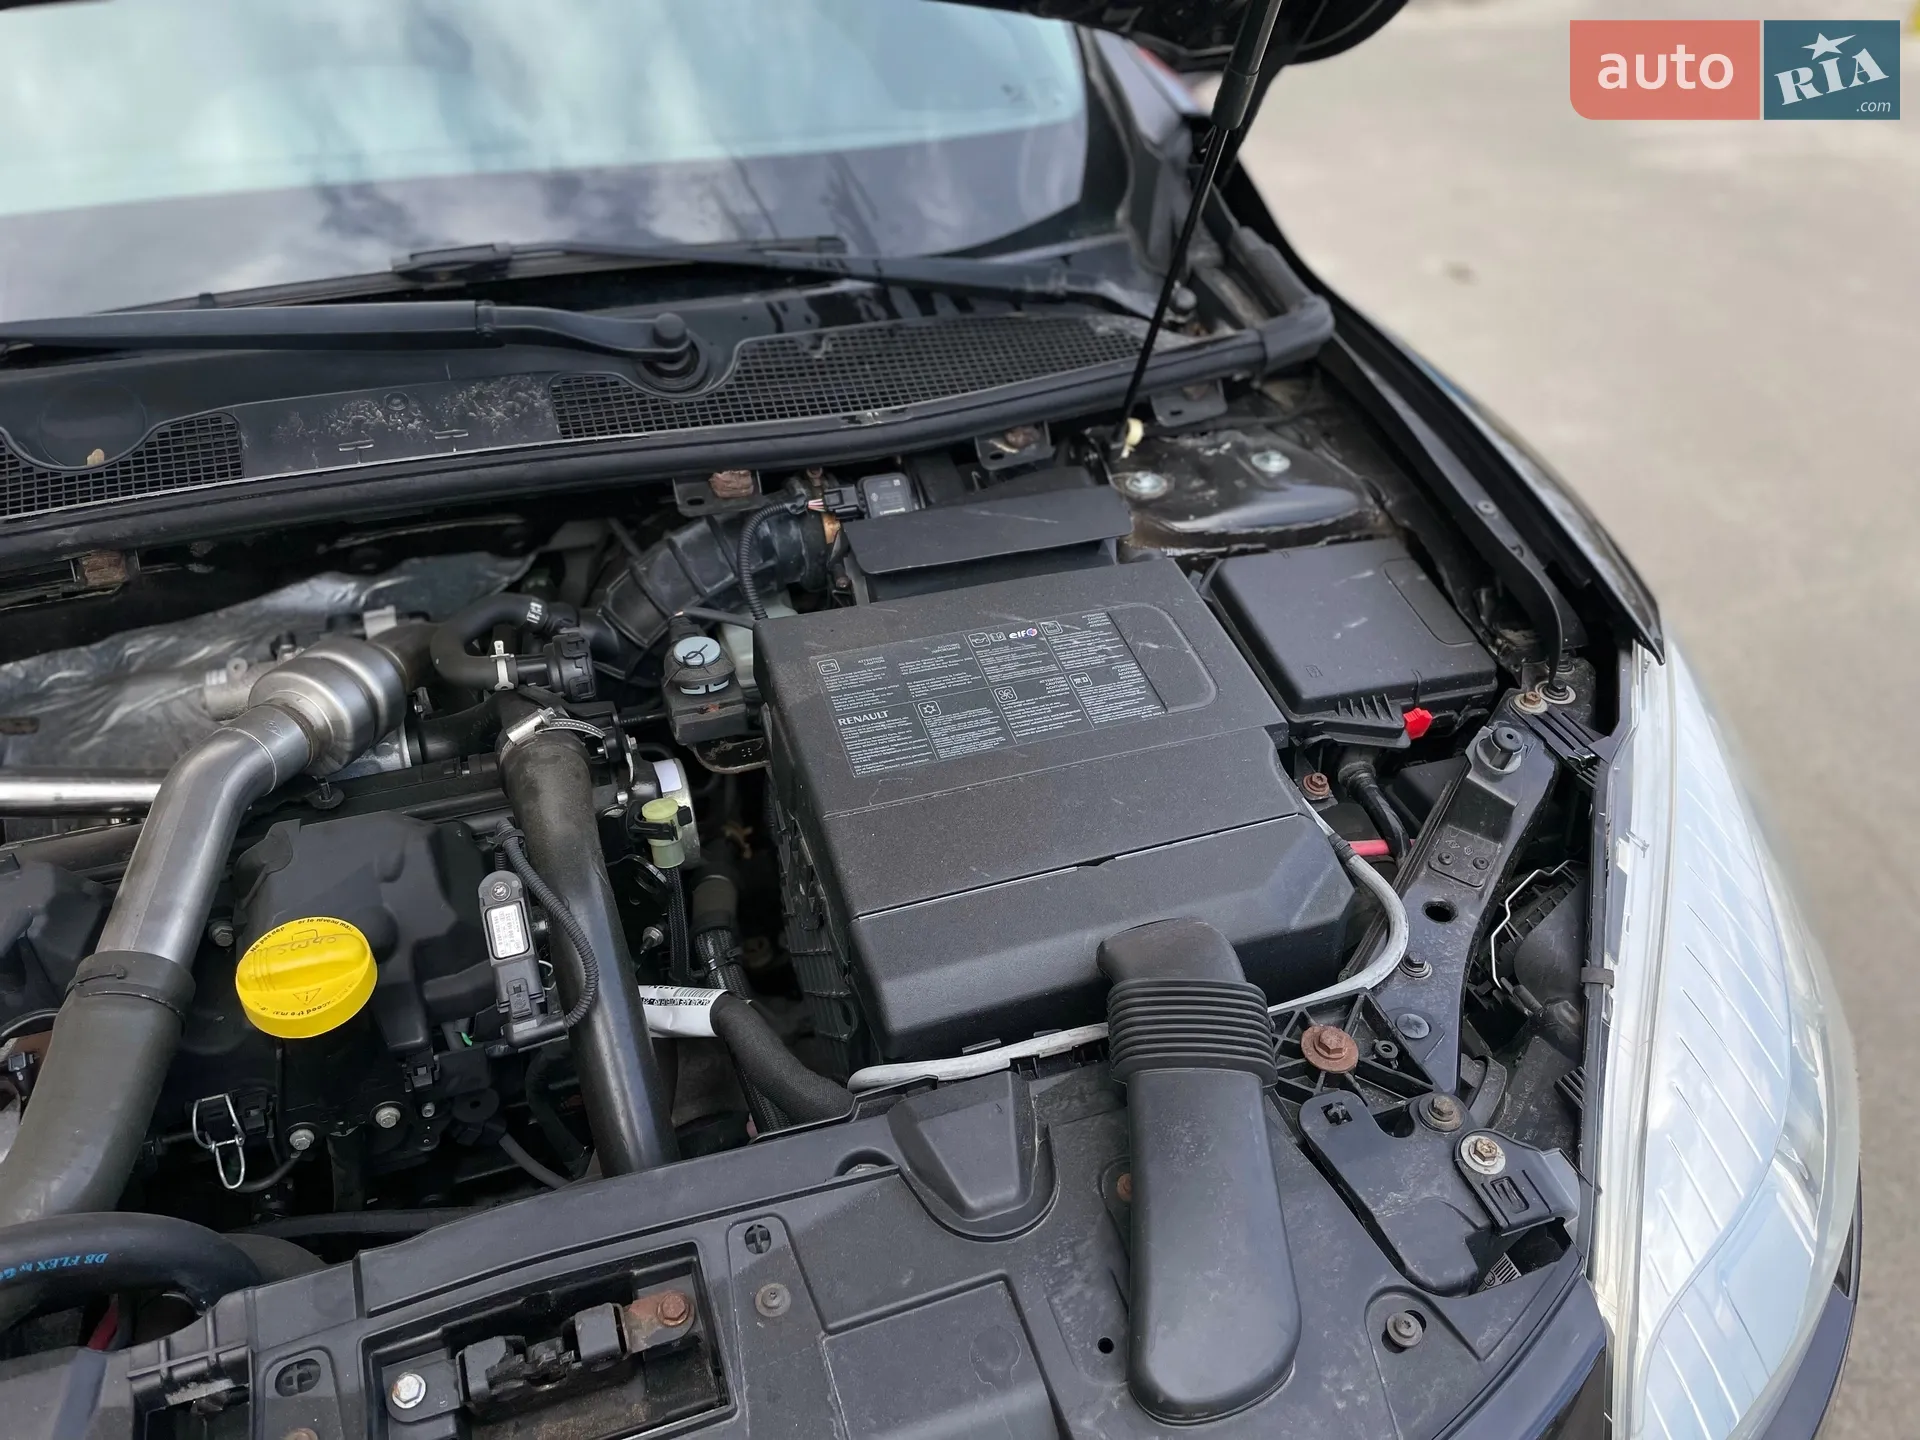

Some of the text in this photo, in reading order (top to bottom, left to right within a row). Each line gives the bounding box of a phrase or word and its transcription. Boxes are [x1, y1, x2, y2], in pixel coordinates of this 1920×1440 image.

[1009, 630, 1026, 639] elf
[838, 710, 889, 725] RENAULT
[36, 1255, 81, 1272] FLEX
[84, 1253, 109, 1264] DB
